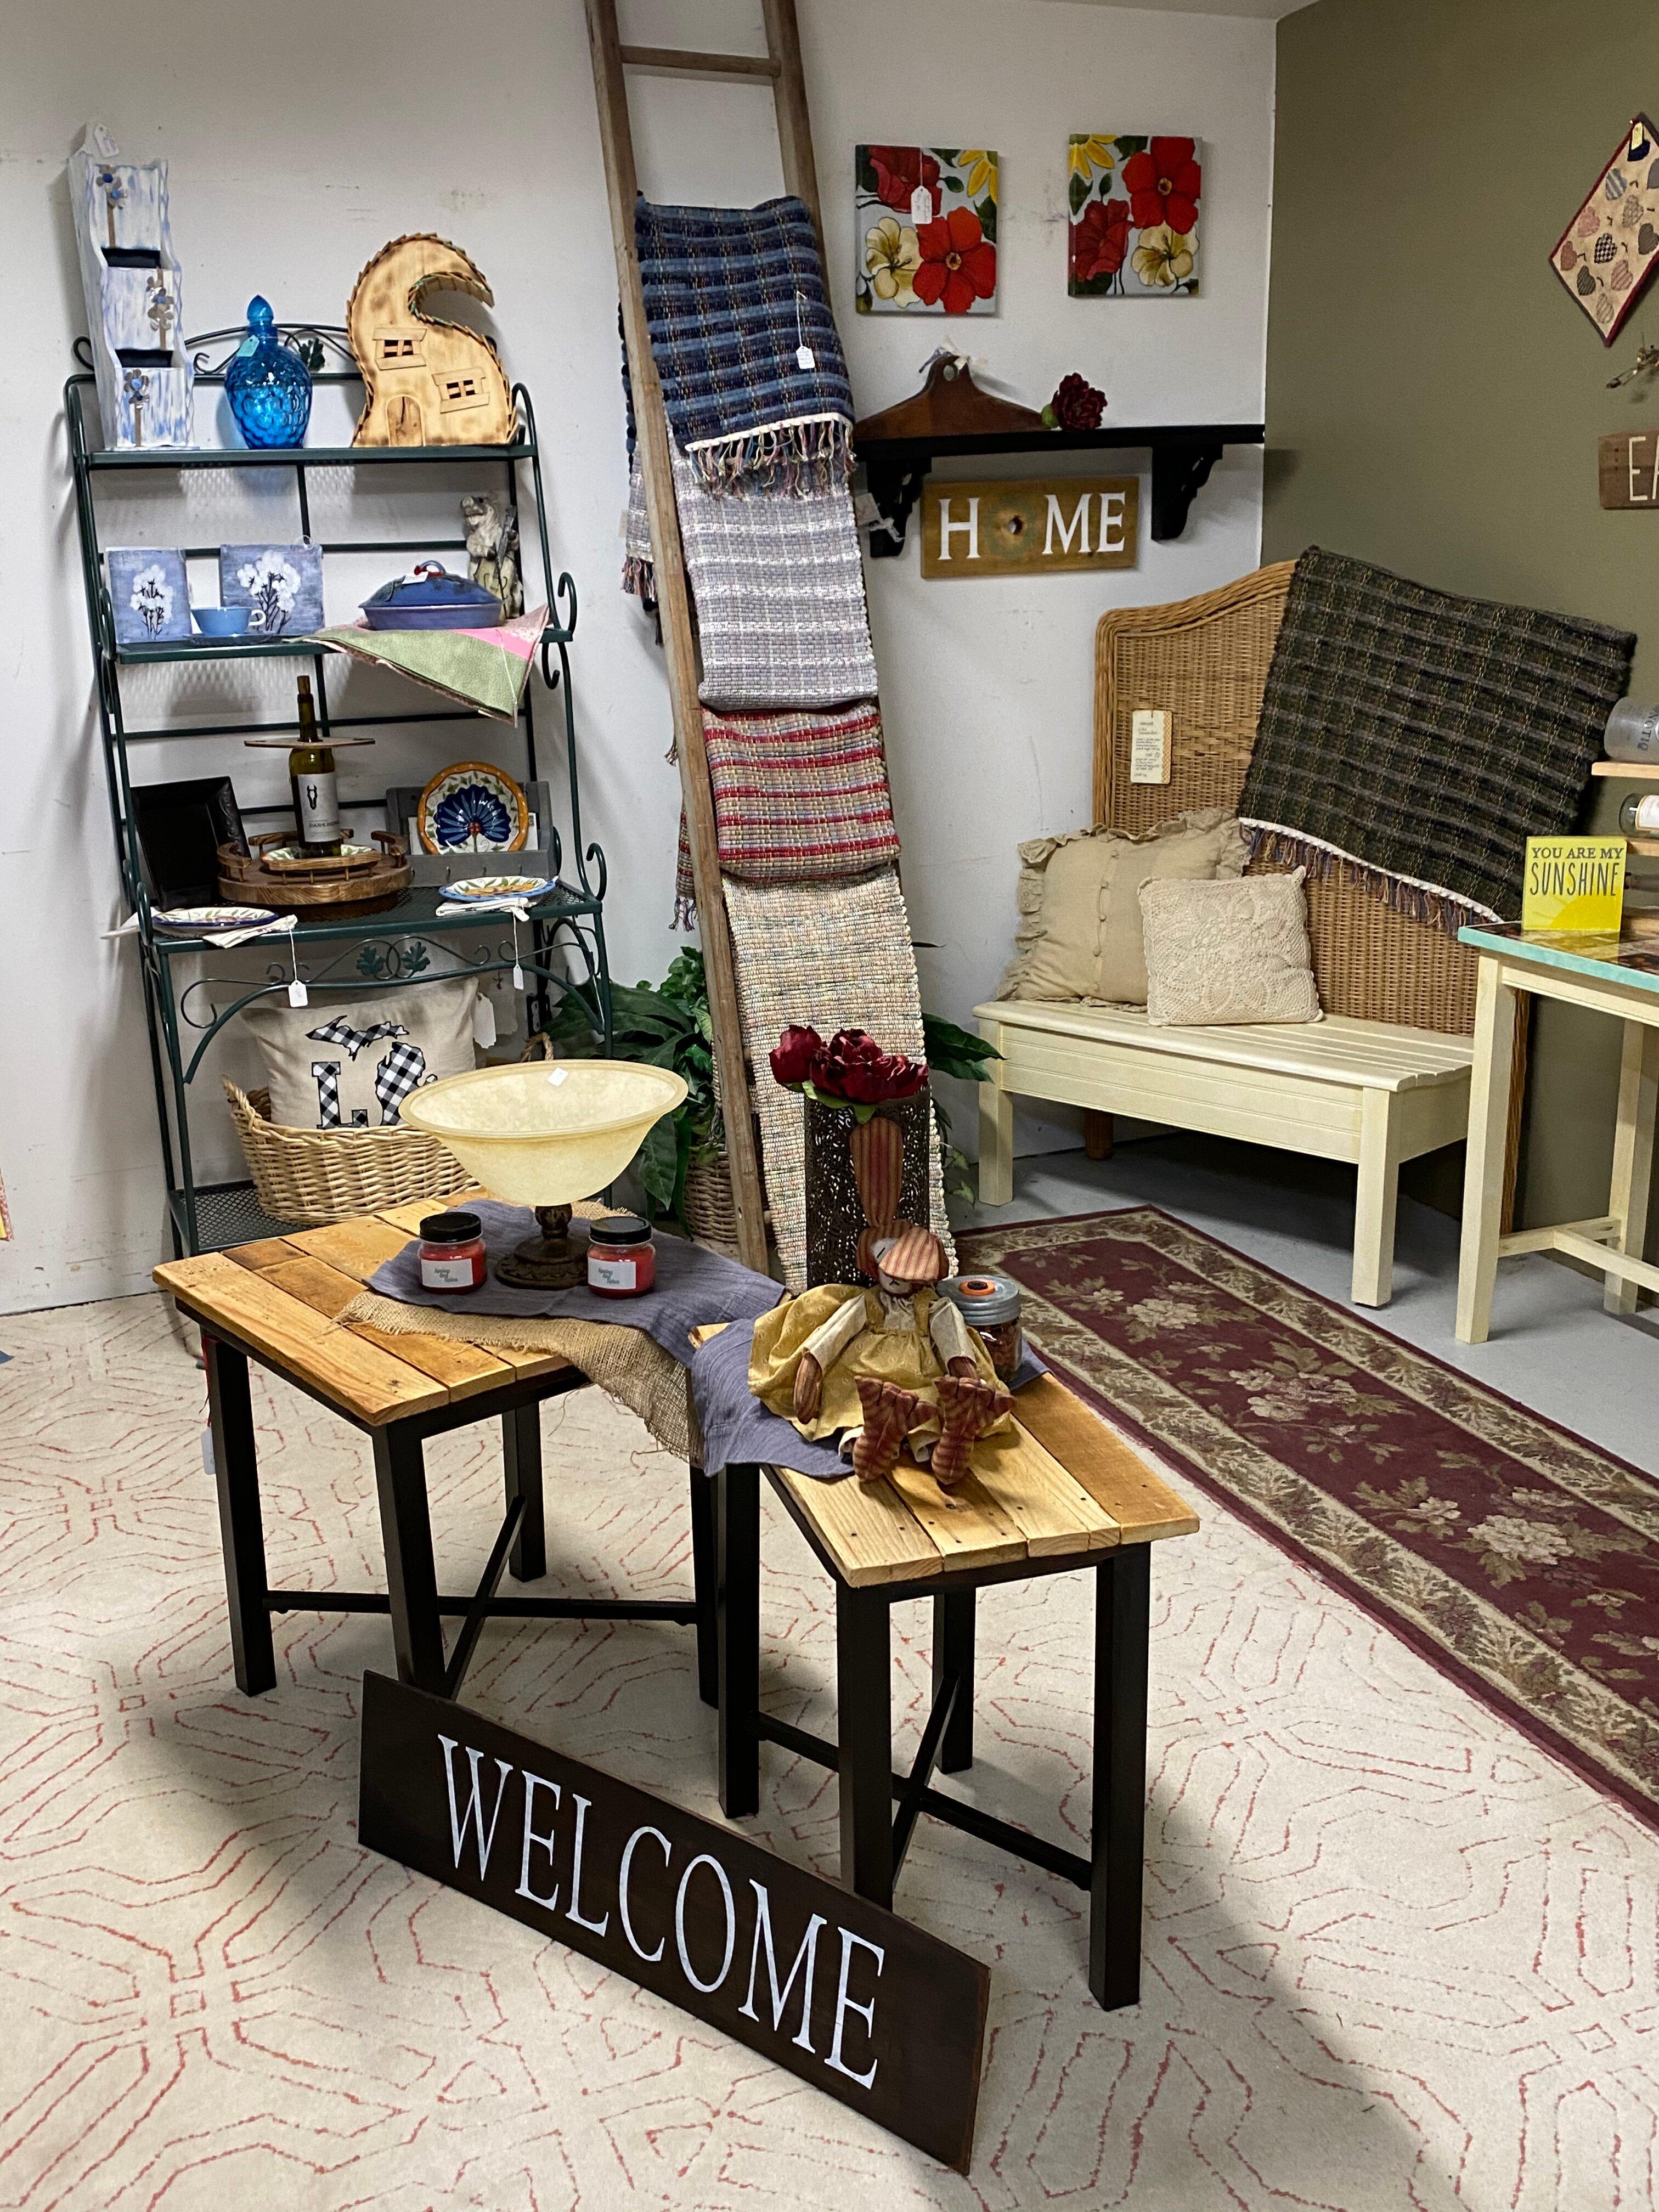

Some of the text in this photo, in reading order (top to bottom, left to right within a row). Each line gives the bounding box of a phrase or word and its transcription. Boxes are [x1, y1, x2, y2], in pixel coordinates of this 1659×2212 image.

[1531, 847, 1624, 859] YOU ARE MY
[1530, 861, 1620, 896] SUNSHINE
[437, 1733, 885, 2090] WELCOME
